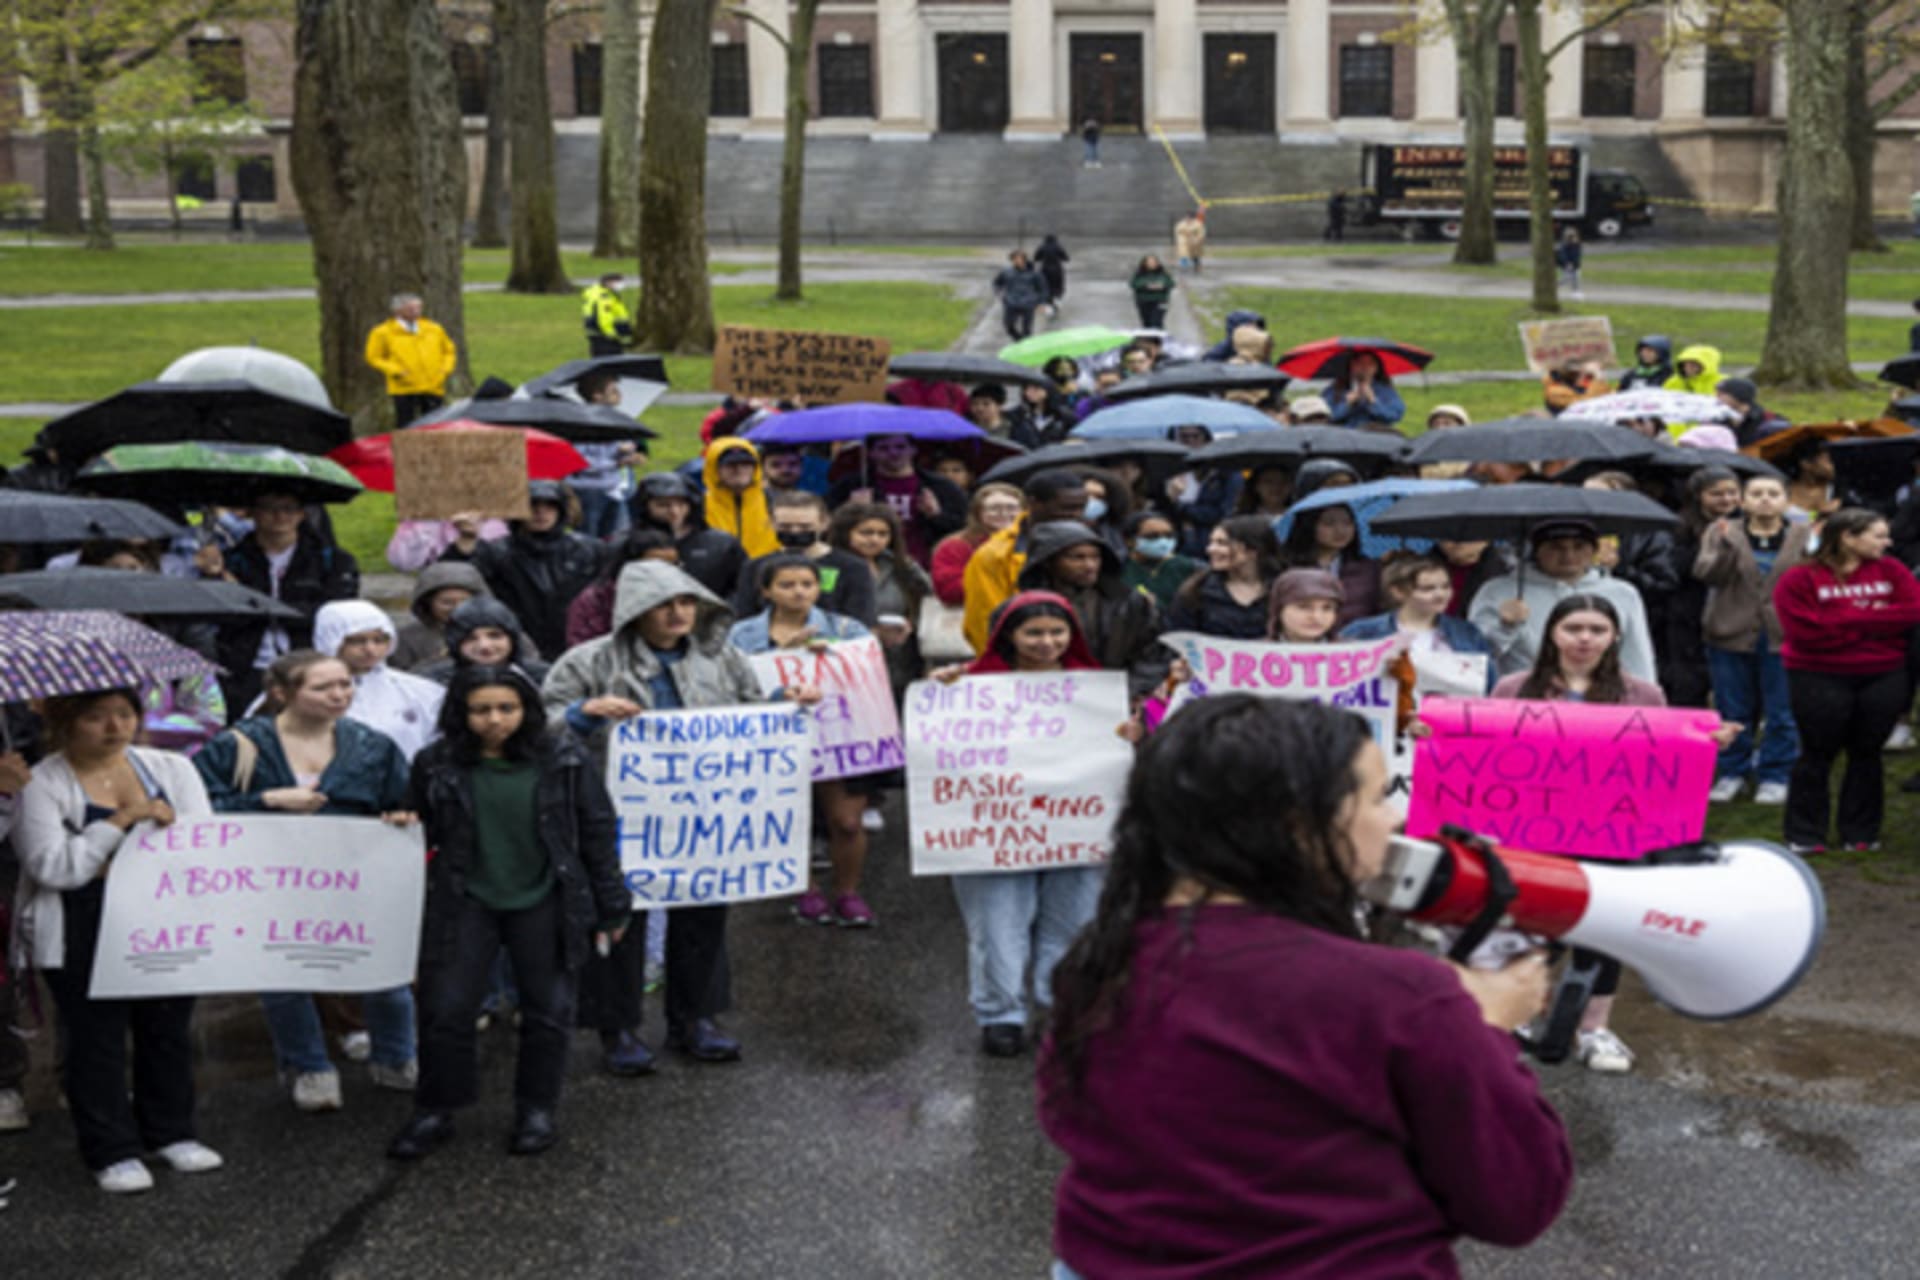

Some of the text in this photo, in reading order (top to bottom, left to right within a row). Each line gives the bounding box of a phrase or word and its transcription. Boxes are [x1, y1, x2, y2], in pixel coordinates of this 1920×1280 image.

[725, 327, 875, 350] THE SYSTEM
[1203, 639, 1395, 688] PROTECT
[918, 711, 1067, 743] want to
[1613, 709, 1657, 747] A
[618, 746, 798, 785] RIGHTS
[936, 746, 1009, 769] have
[1427, 739, 1682, 791] WOMAN
[670, 787, 758, 805] are
[932, 772, 1024, 805] BASIC
[1434, 781, 1567, 813] NOT
[1607, 794, 1643, 821] A
[615, 808, 794, 860] HUMAN
[923, 824, 1048, 849] HUMAN
[993, 841, 1109, 867] RIGHTS
[154, 865, 361, 900] ABORTION
[624, 857, 798, 902] RIGHTS
[128, 918, 375, 954] SAFE LEGAL
